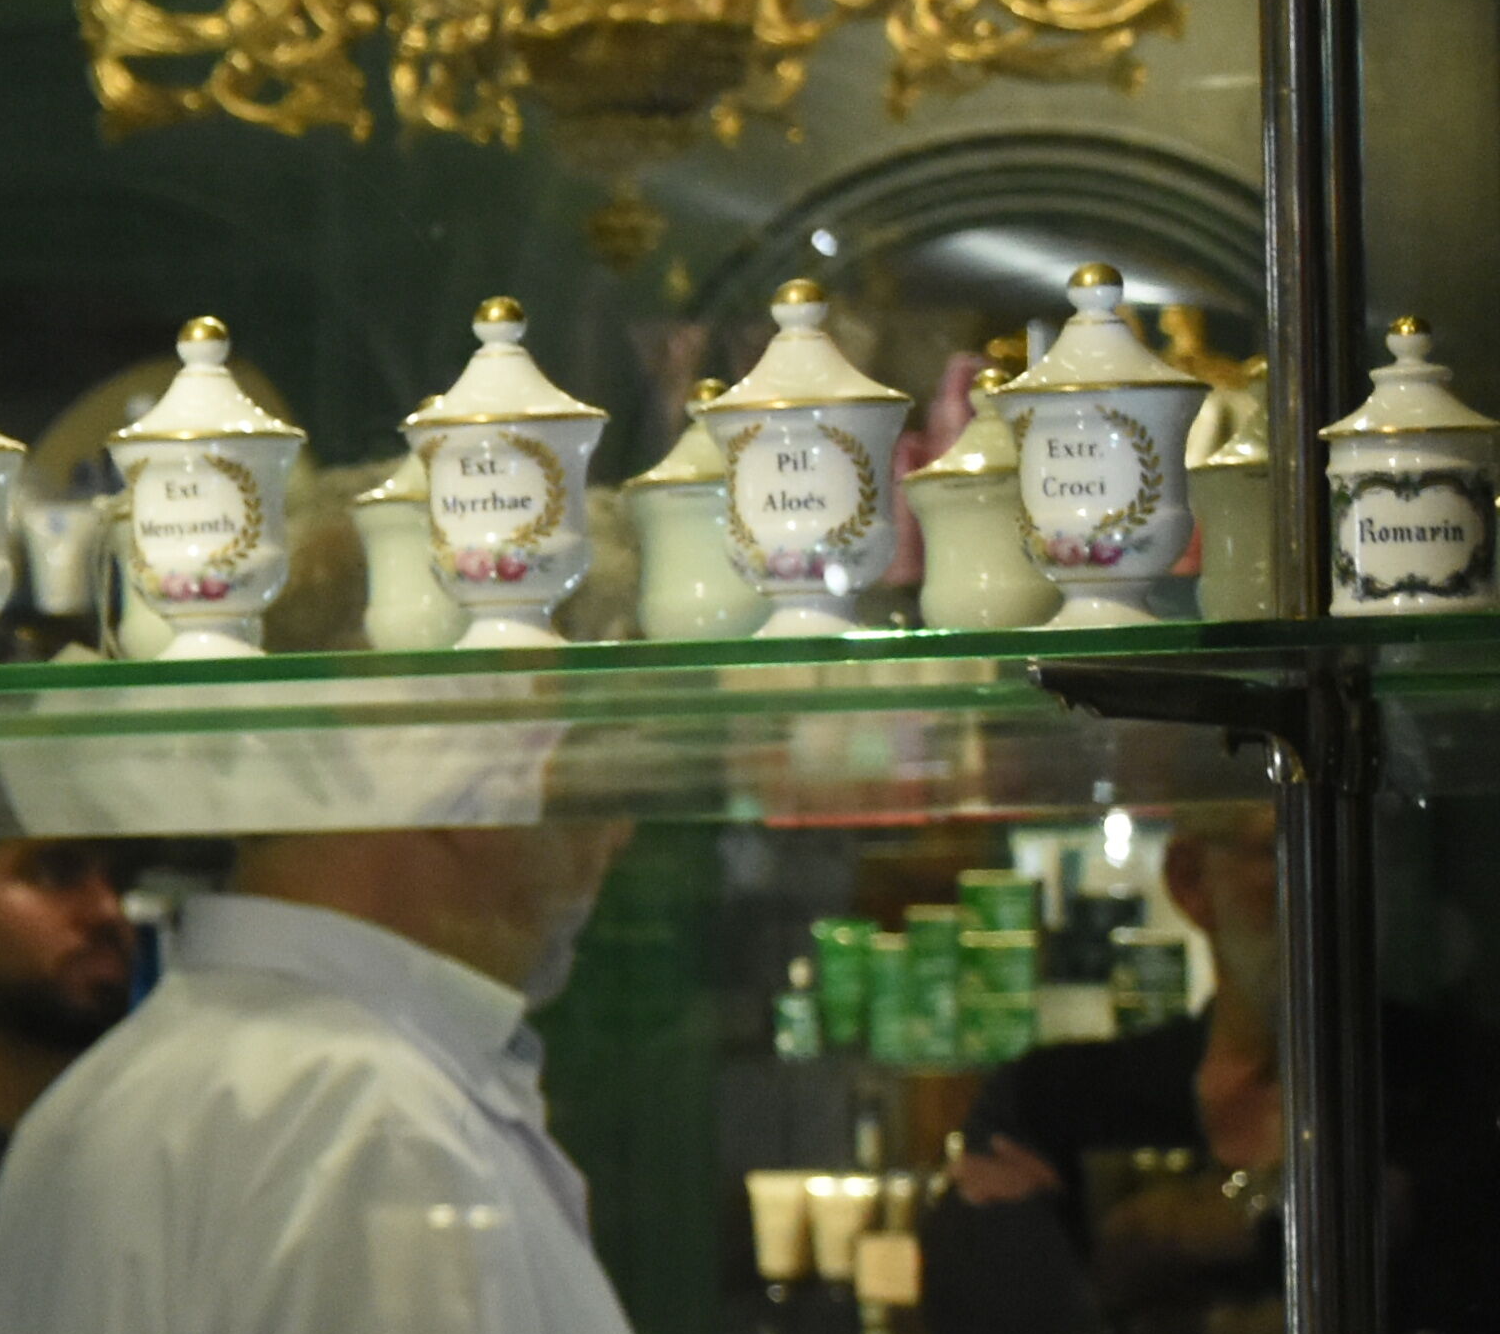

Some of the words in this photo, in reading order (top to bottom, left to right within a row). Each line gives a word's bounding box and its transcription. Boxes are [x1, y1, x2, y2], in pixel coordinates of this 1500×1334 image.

[775, 450, 817, 473] Pil.
[1046, 437, 1105, 462] Extr.
[1041, 474, 1108, 499] Croci
[1357, 516, 1466, 545] Romarin
